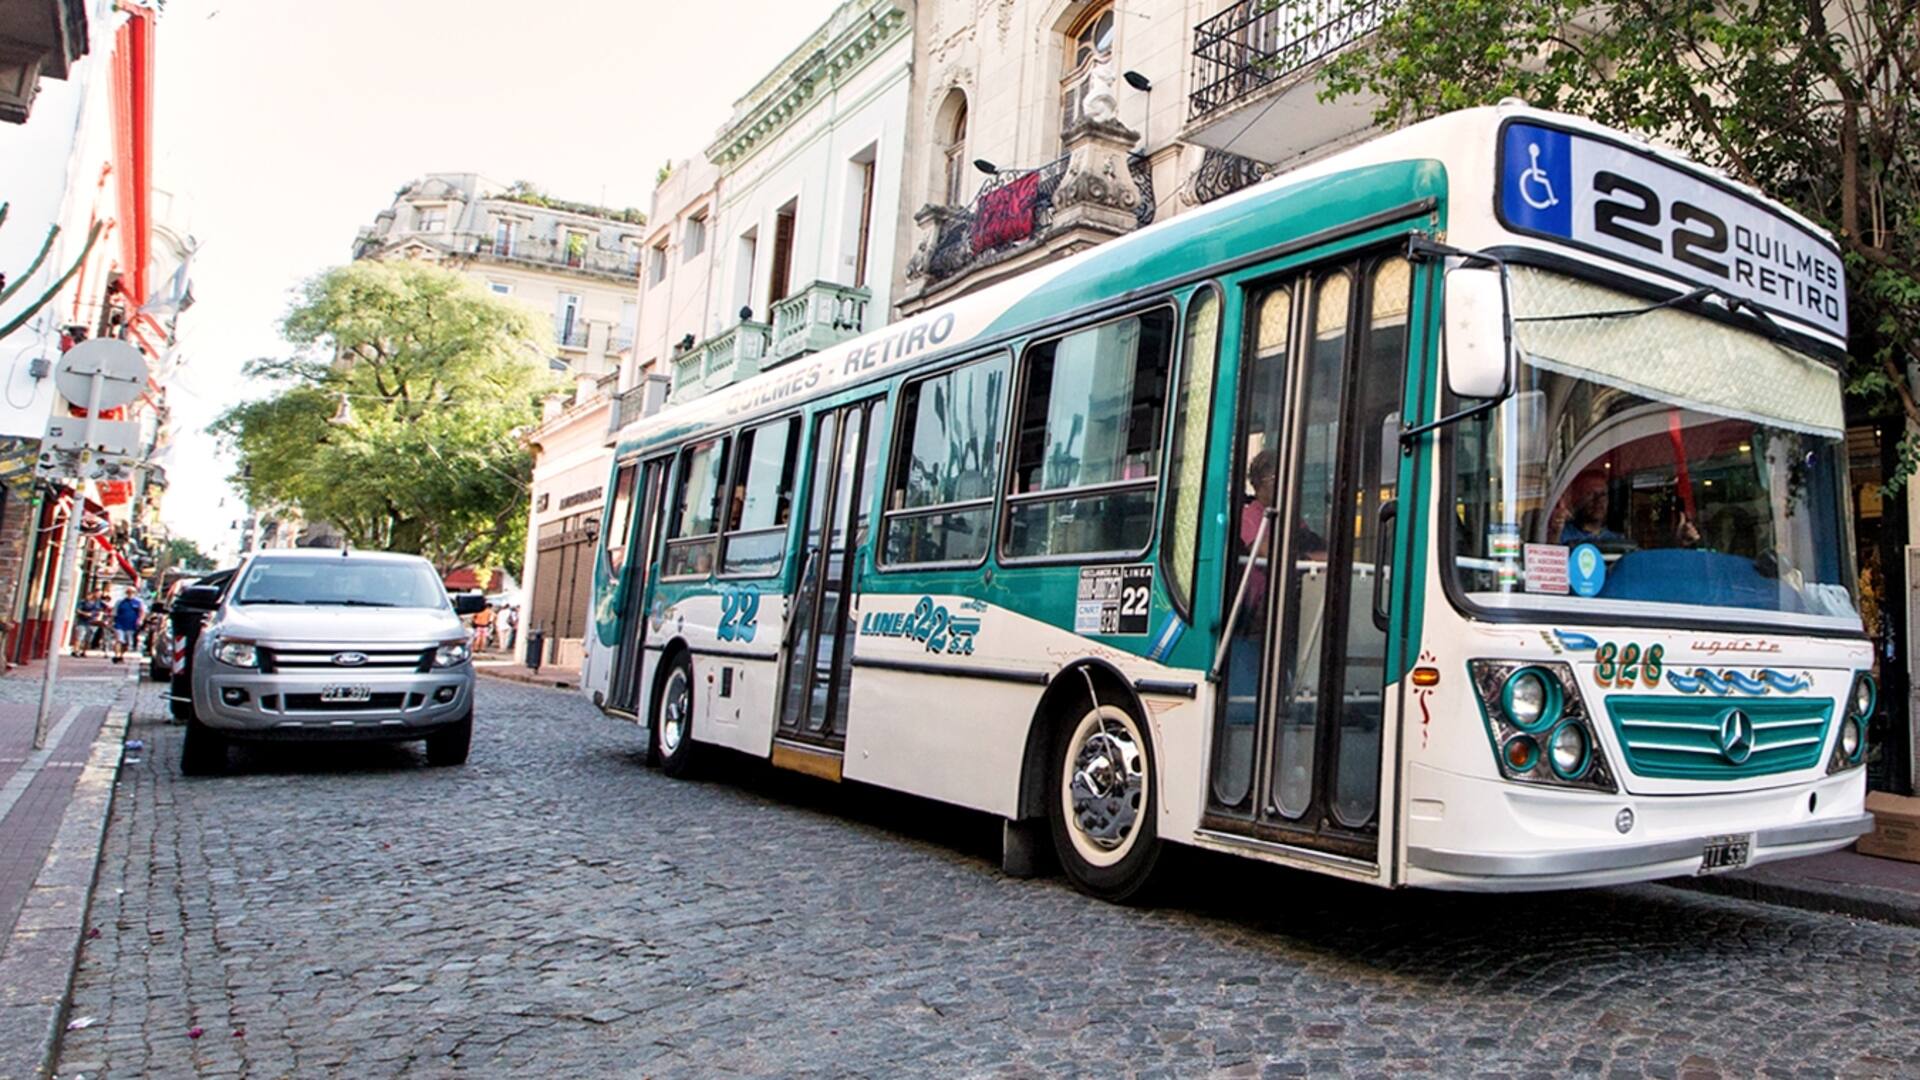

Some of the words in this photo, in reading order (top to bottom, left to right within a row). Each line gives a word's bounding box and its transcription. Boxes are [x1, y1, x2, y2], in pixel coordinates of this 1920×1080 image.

[1593, 170, 1730, 280] 22
[1735, 225, 1838, 290] QUILMES
[1736, 257, 1839, 322] RETIRO
[726, 363, 822, 415] QUILMES
[843, 312, 956, 376] RETIRO
[1121, 586, 1149, 616] 22
[1123, 567, 1152, 578] LINEA
[717, 583, 760, 643] 22
[860, 612, 916, 640] LINEA
[913, 596, 949, 654] 22
[1593, 641, 1664, 689] 328
[1691, 639, 1782, 656] ugarte
